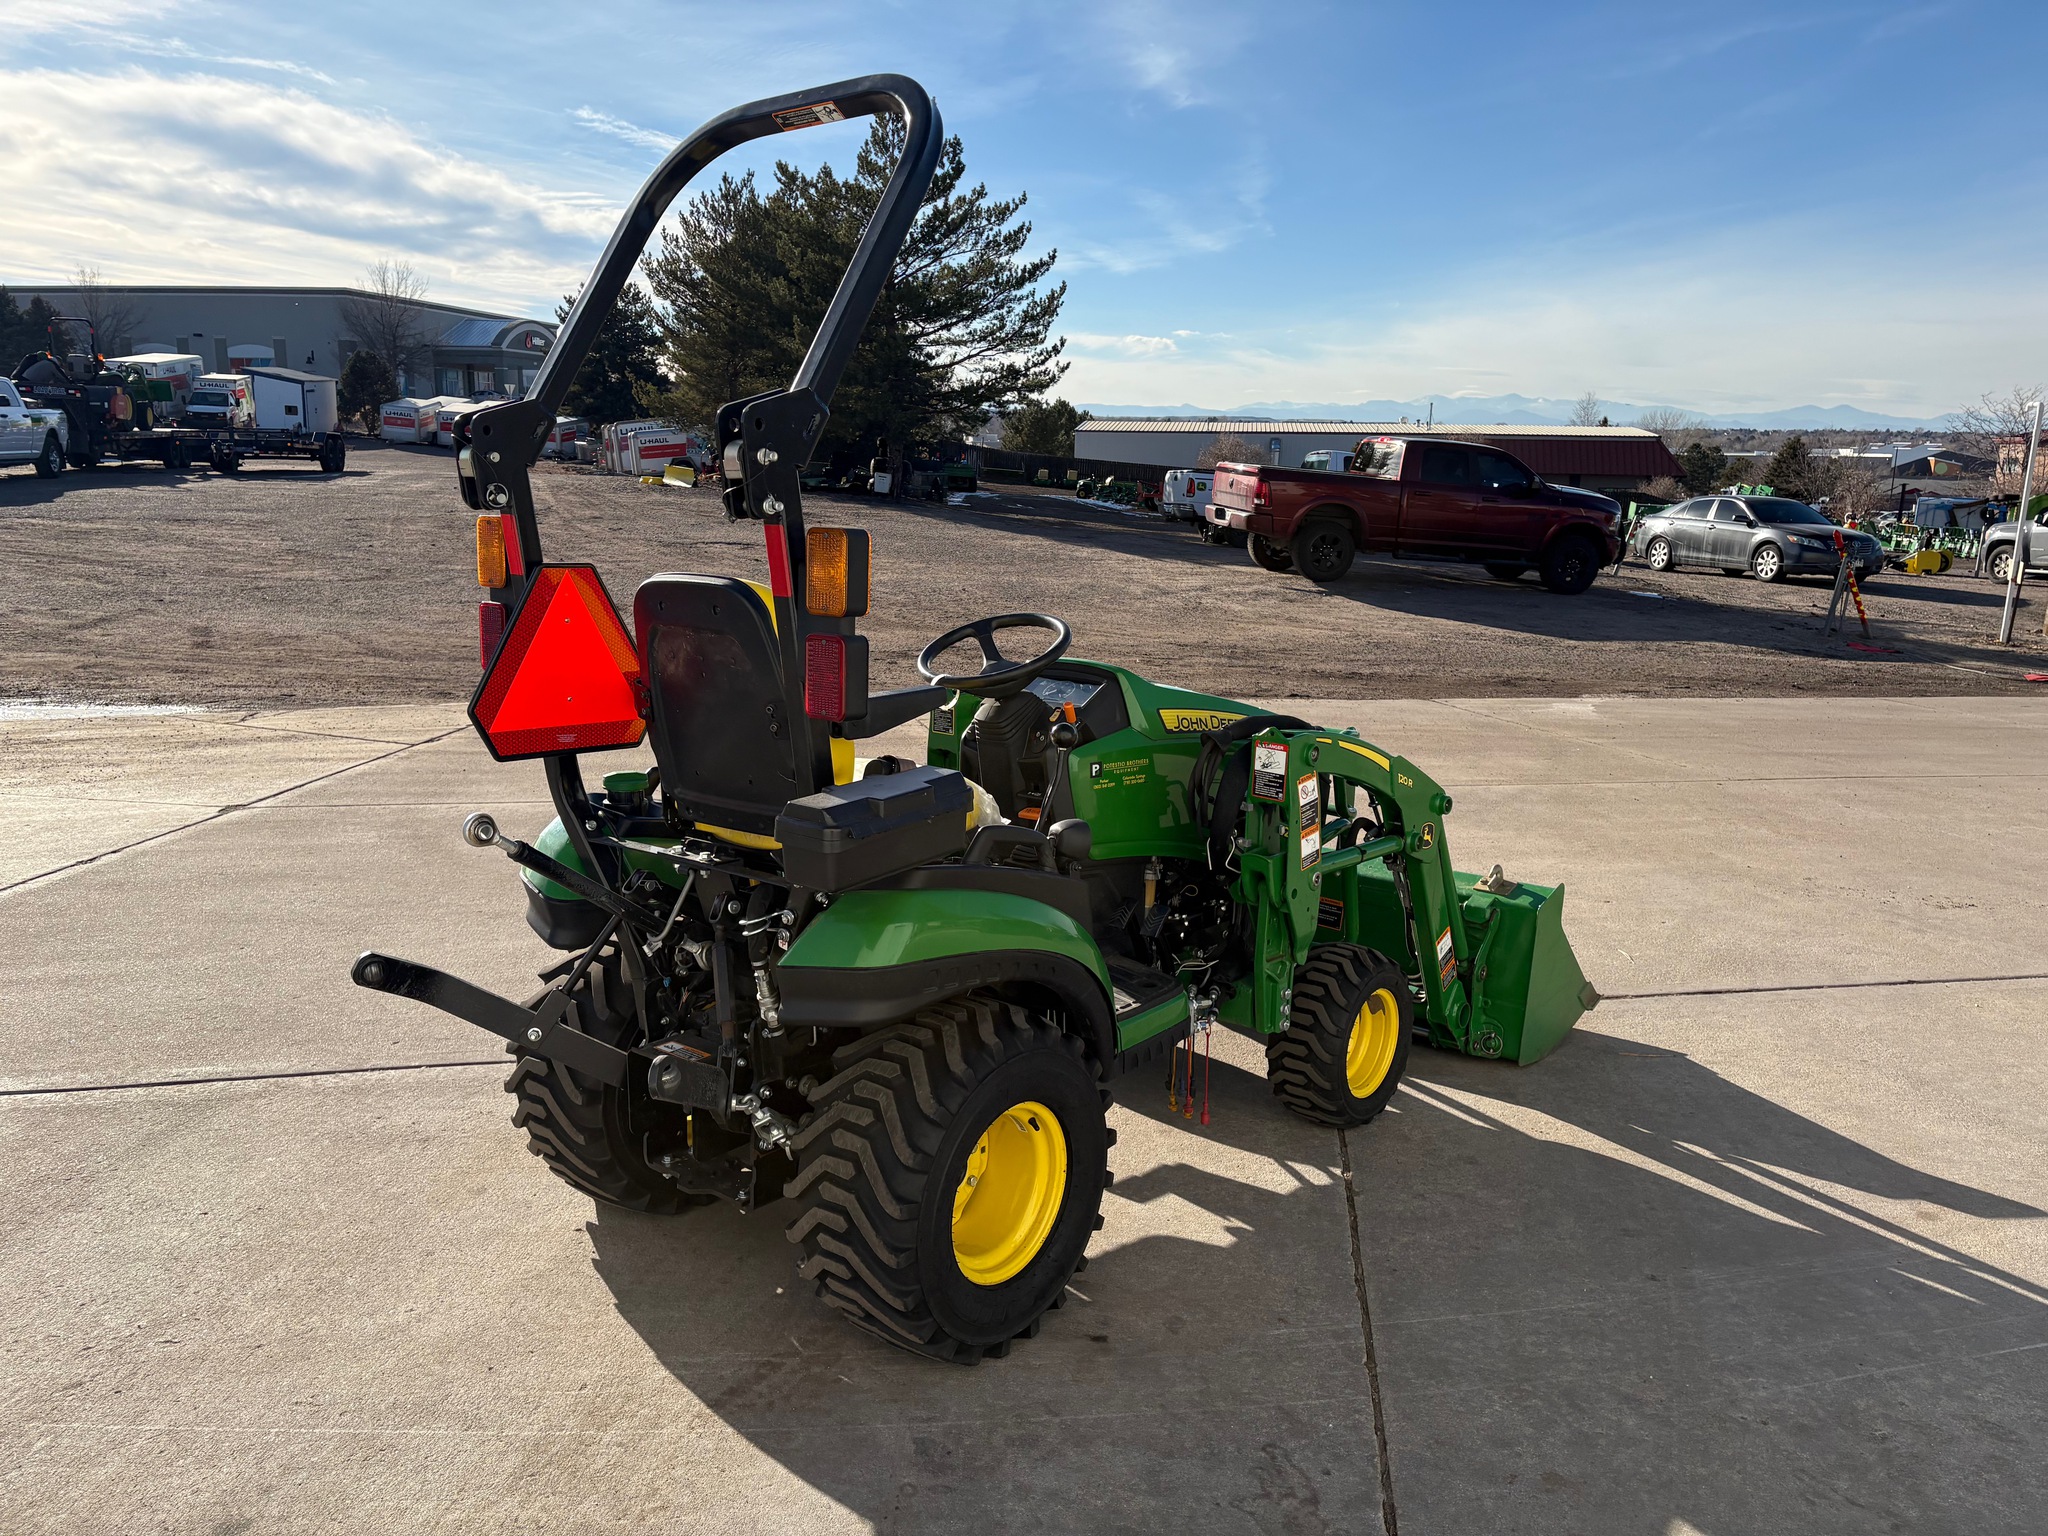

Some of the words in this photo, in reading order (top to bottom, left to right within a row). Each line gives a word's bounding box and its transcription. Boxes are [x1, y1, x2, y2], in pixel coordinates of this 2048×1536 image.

[385, 410, 413, 418] U-HAUL
[640, 437, 669, 445] U-HAUL
[1174, 714, 1208, 729] JOHN
[1126, 758, 1149, 767] BROTHERS
[1092, 764, 1100, 776] P
